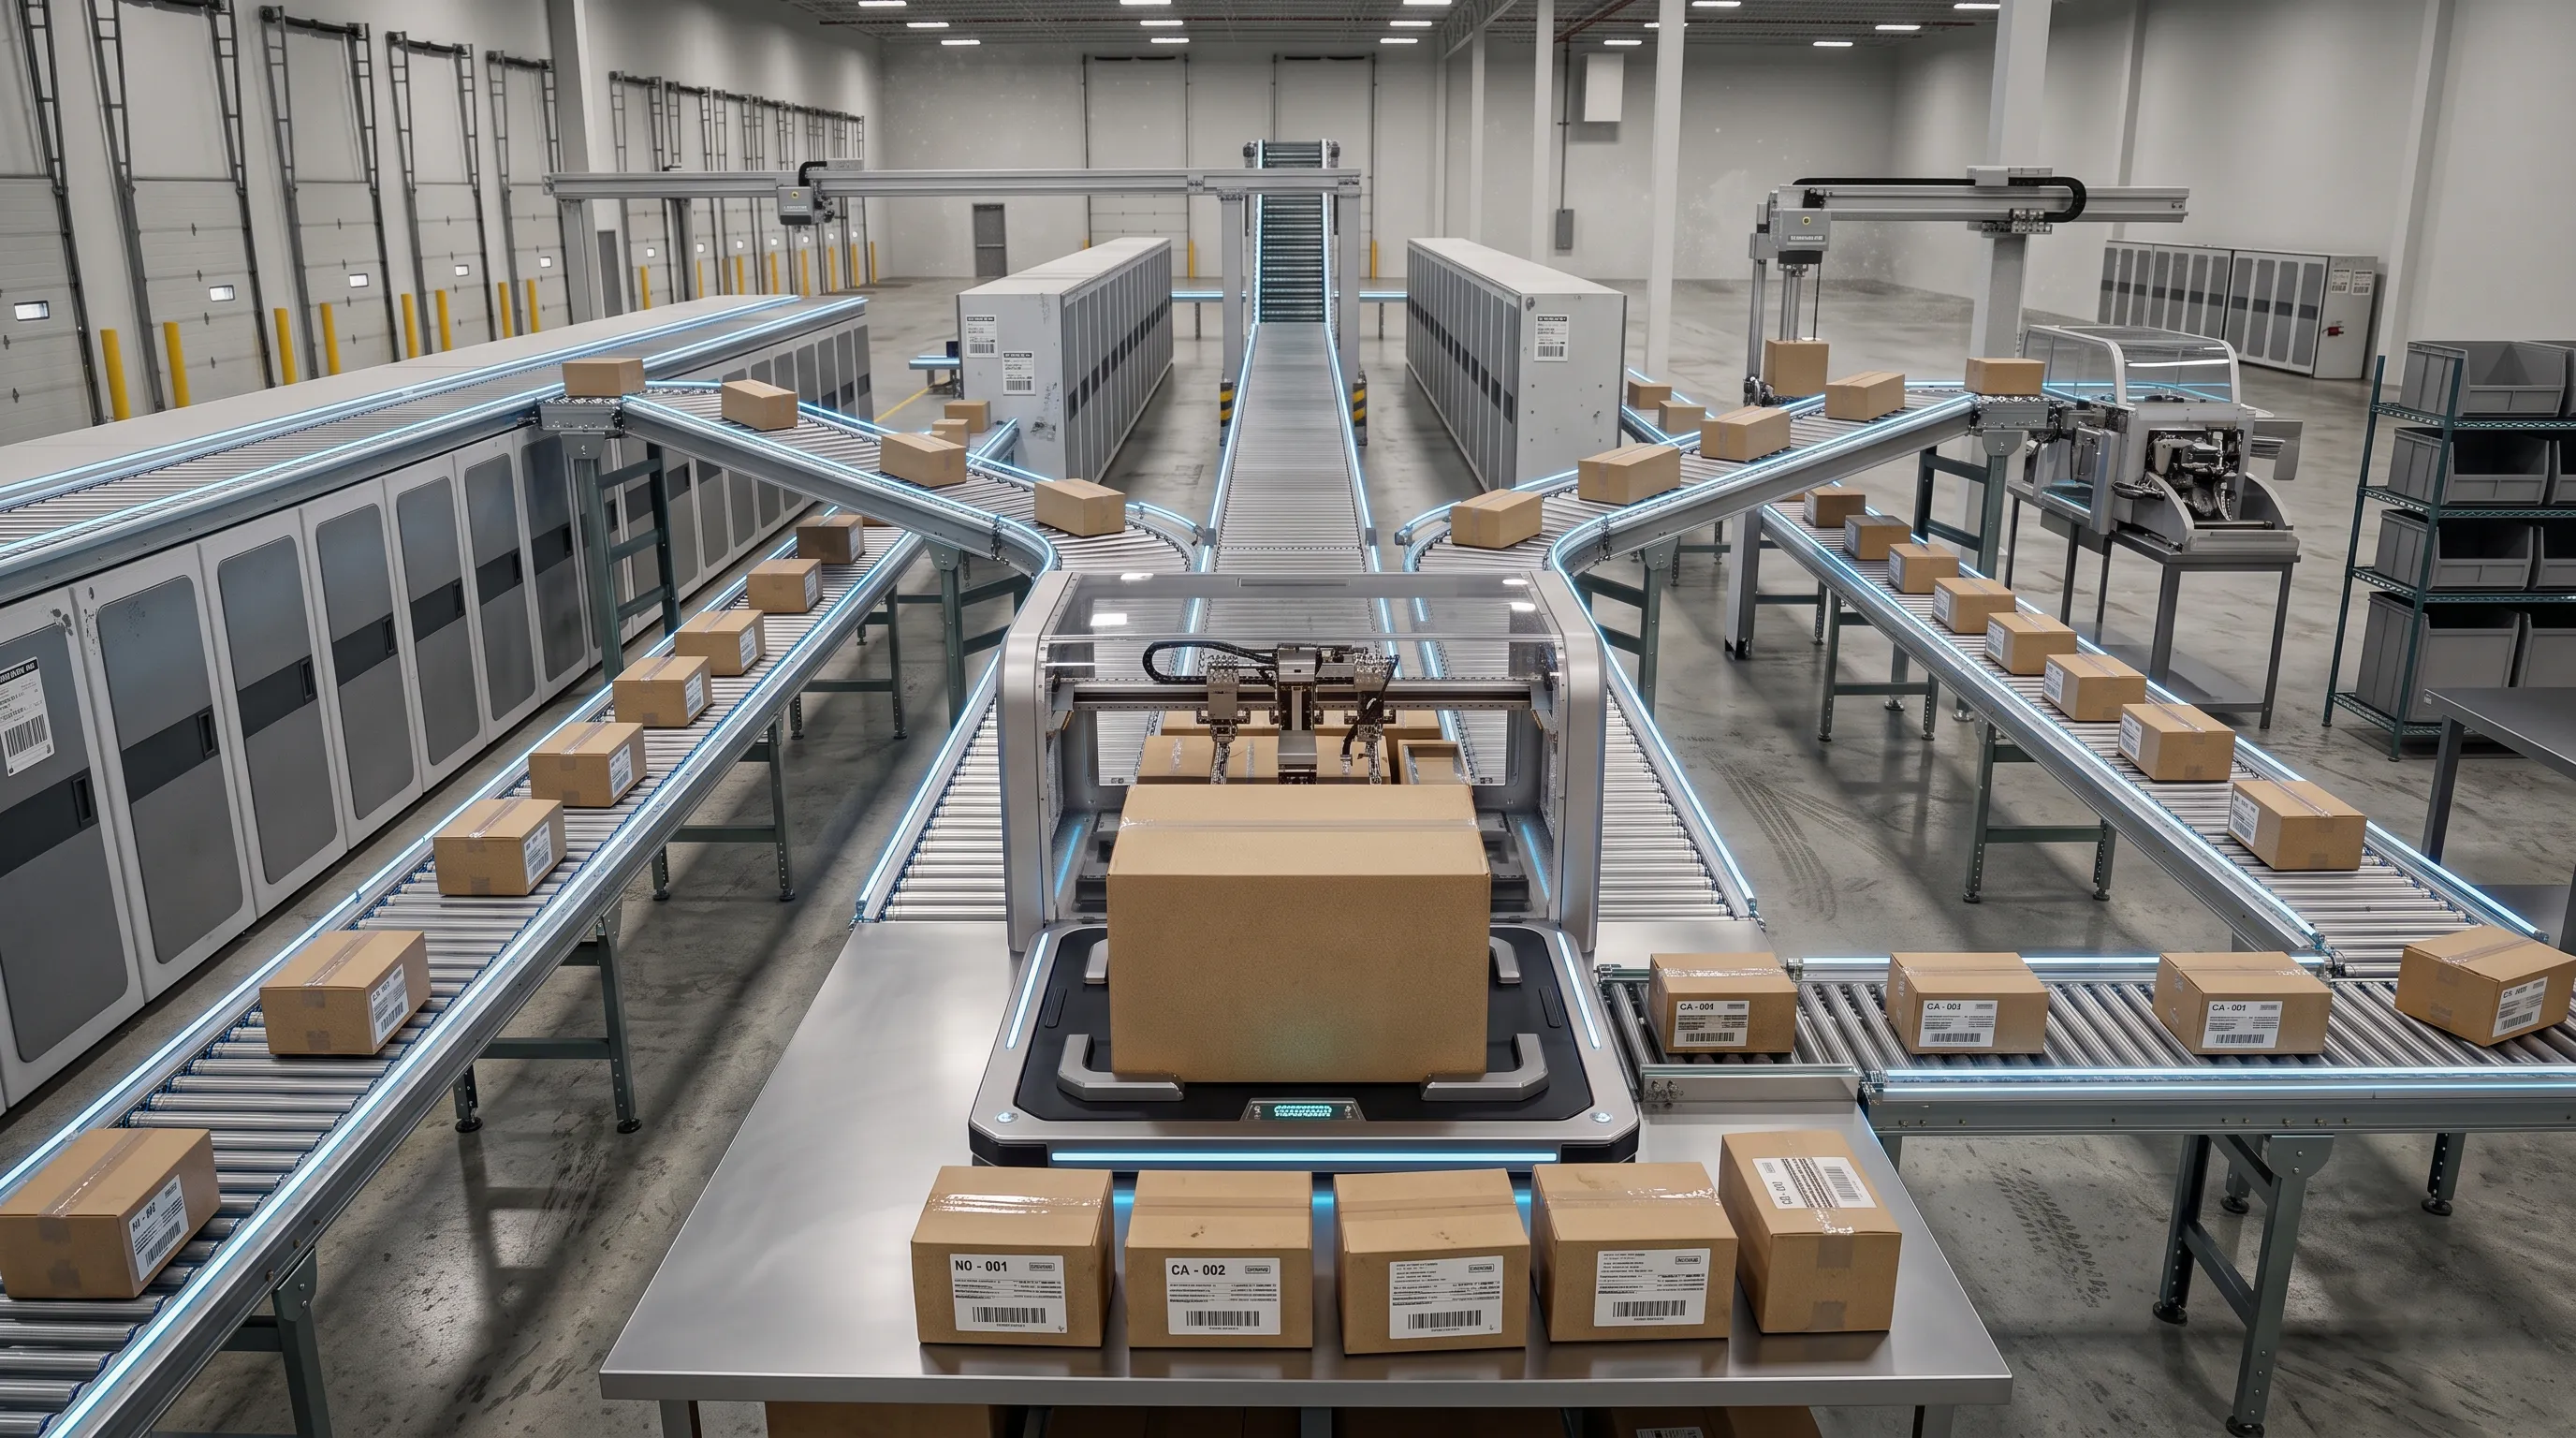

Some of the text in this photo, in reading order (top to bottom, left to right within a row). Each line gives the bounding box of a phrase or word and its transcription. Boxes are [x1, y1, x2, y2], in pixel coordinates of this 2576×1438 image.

[1679, 1003, 1693, 1011] CA
[955, 1260, 973, 1271] NO
[985, 1260, 1007, 1272] 001
[1171, 1264, 1190, 1276] CA
[1202, 1264, 1226, 1276] 002
